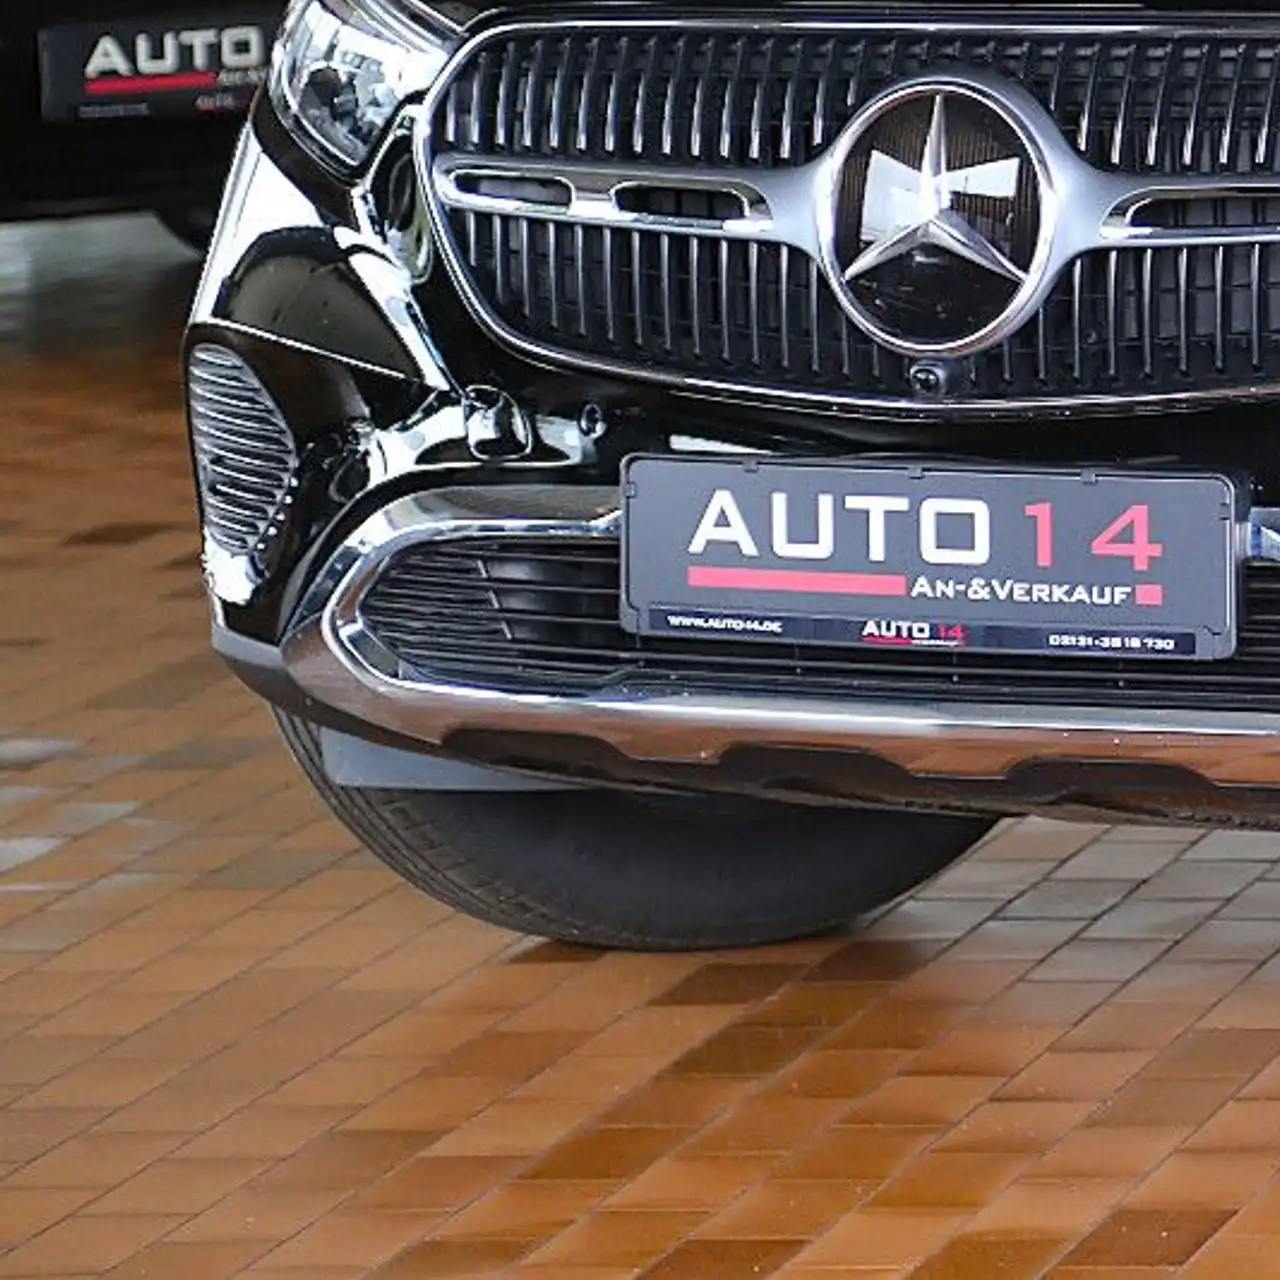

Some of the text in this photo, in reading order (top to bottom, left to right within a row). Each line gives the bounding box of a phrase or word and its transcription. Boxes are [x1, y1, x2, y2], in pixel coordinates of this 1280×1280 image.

[83, 25, 265, 78] AUTO
[688, 489, 1163, 571] AUTO 14
[862, 620, 930, 638] AUTO
